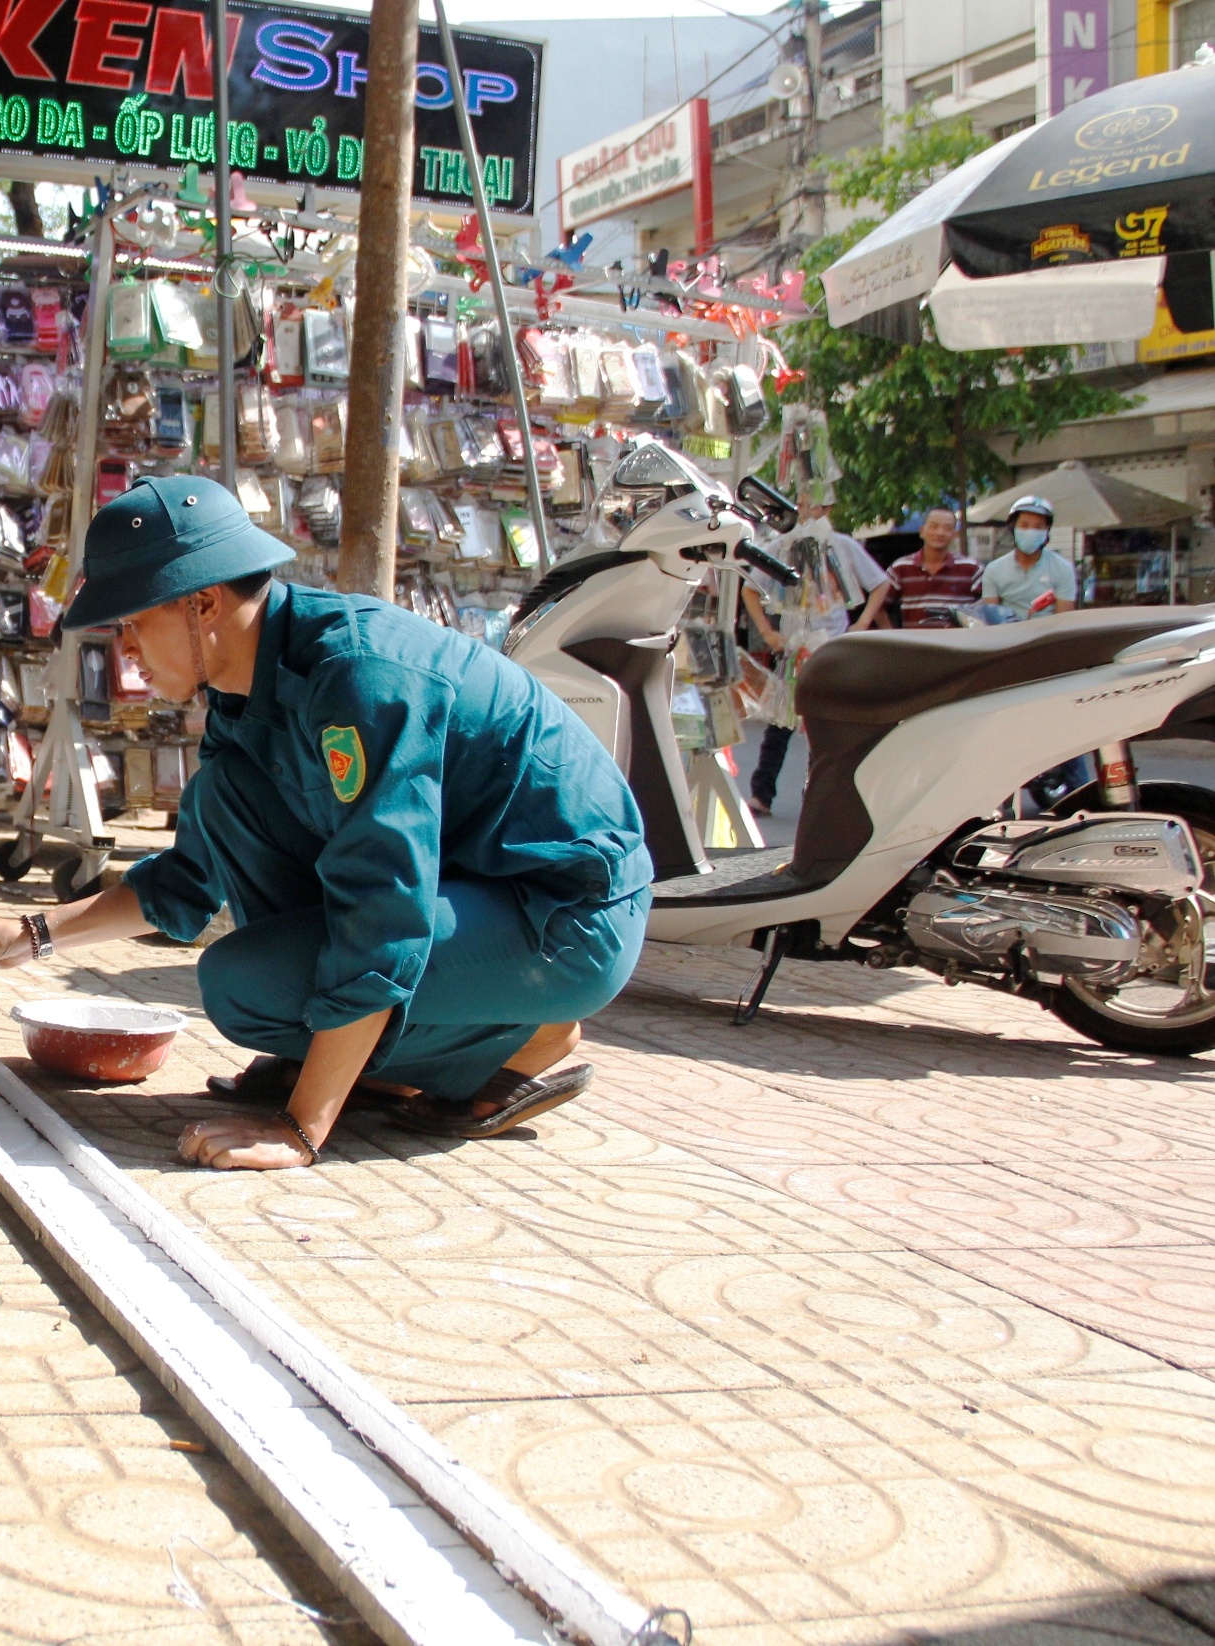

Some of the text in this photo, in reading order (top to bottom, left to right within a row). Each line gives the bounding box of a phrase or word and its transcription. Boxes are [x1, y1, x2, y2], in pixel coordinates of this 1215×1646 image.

[37, 97, 85, 149] DA
[114, 93, 165, 156] ỐP
[285, 116, 330, 177] VỎ
[1028, 142, 1191, 192] Legend
[1114, 206, 1170, 241] G7
[1075, 672, 1188, 705] VISION
